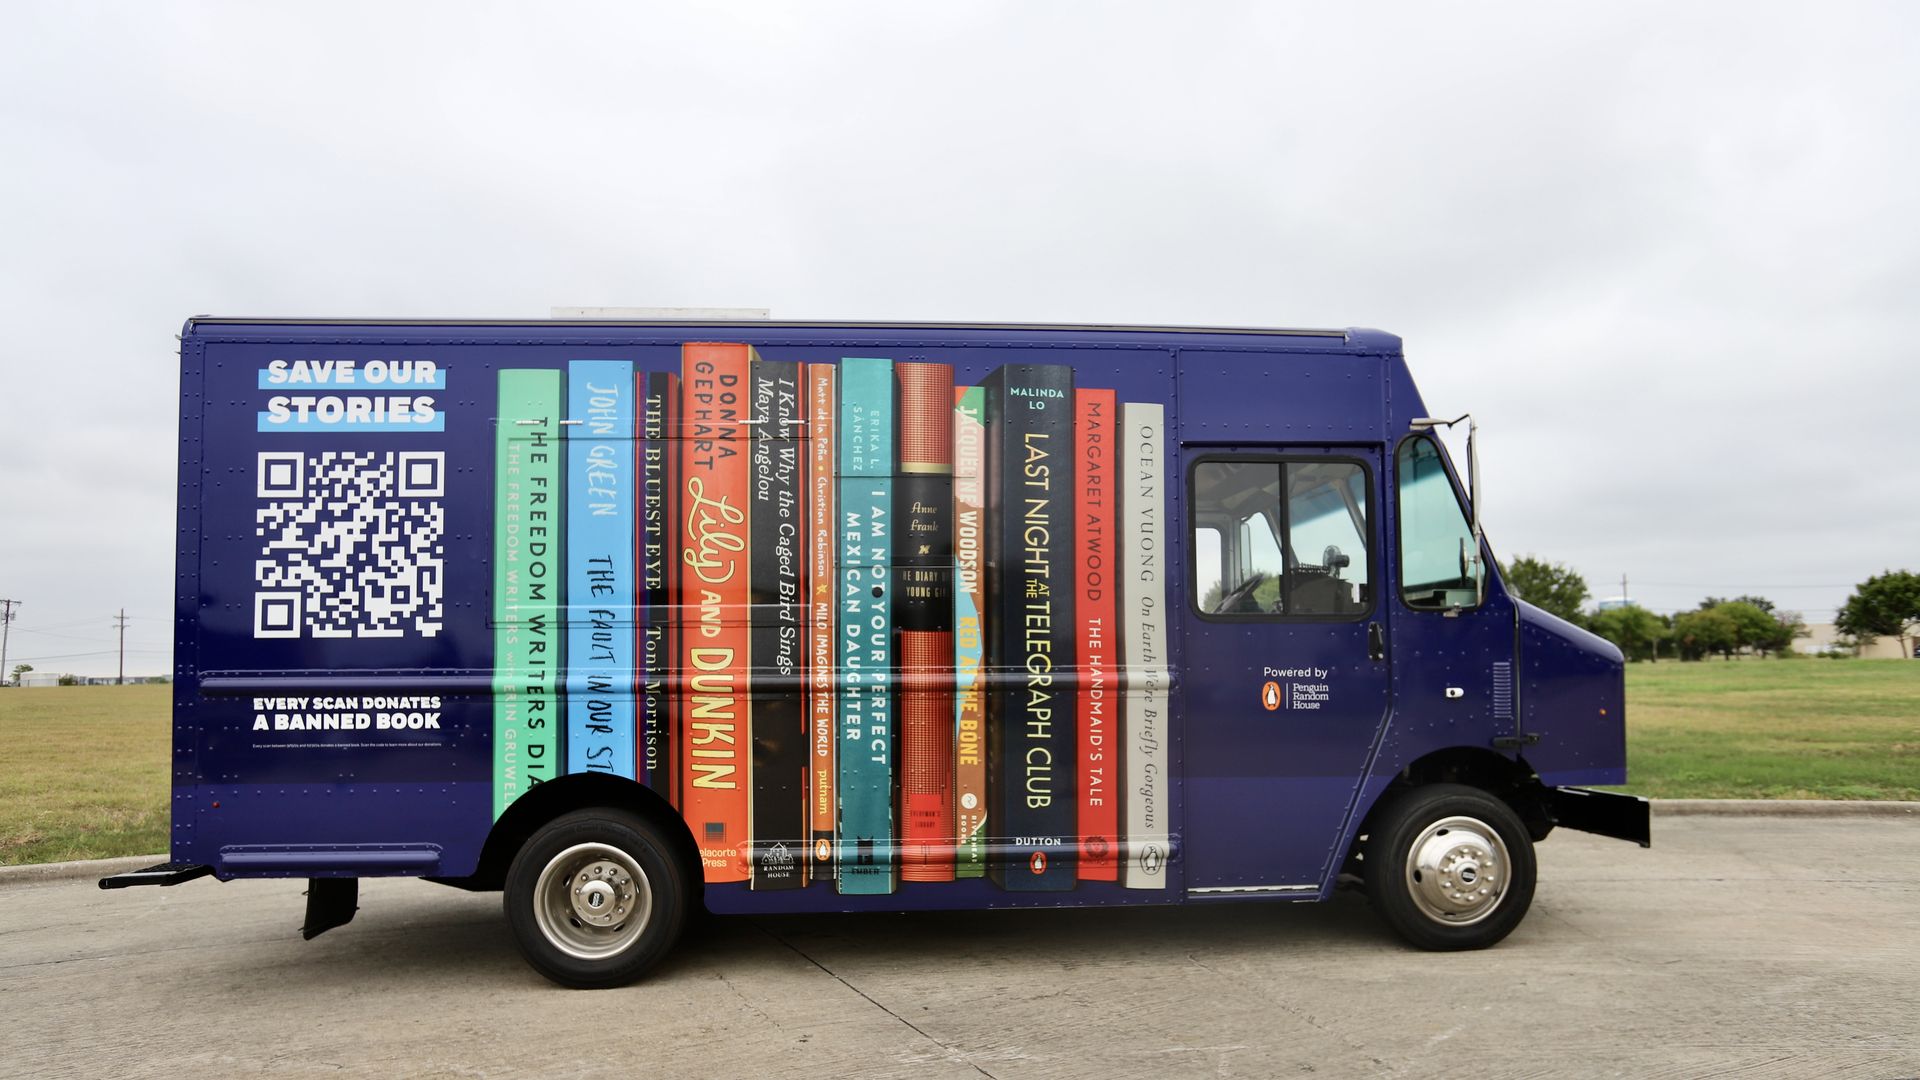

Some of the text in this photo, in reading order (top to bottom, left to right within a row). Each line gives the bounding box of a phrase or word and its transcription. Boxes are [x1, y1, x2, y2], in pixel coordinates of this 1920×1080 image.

[268, 359, 436, 384] SAVE OUR
[817, 377, 828, 404] Matt
[267, 396, 436, 424] STORIES
[1010, 387, 1064, 398] MALINDA
[1029, 401, 1045, 410] LO
[693, 361, 714, 470] GEPHART
[718, 374, 738, 459] DONNA
[817, 408, 828, 420] de
[817, 423, 828, 433] la
[586, 382, 618, 516] JOHN GREEN
[754, 377, 774, 501] Maya Angelou
[852, 406, 863, 471] SÁNCHEZ
[870, 410, 880, 469] ERIKA L.
[508, 445, 520, 474] THE
[645, 394, 661, 590] THE BLUEST EYE
[817, 476, 828, 524] Christian
[910, 501, 937, 513] Anne
[959, 405, 978, 593] JACQUELINE WOODSON
[507, 483, 520, 562] FREEDOM
[775, 377, 795, 675] I Know Why the Caged Bird Sings
[871, 506, 886, 537] AM
[910, 519, 938, 531] Frank
[817, 529, 828, 577] Robinson
[871, 548, 886, 594] NOT
[587, 555, 615, 598] THE
[906, 586, 930, 597] YOUNG
[915, 571, 938, 581] DIARY
[504, 567, 519, 645] WRITERS
[527, 417, 548, 789] THE FREEDOM WRITERS DIA
[816, 602, 828, 629] MILO
[1024, 433, 1052, 809] LAST NIGHT AT THE TELEGRAPH CLUB
[1087, 402, 1103, 807] MARGARET ATWOOD THE HANDMAID'S TALE
[589, 609, 616, 664] FAULT
[684, 476, 745, 789] Lily AND DUNKIN
[846, 512, 861, 740] MEXICAN DAUGHTER
[871, 602, 886, 662] YOUR
[1139, 426, 1159, 828] OCEAN VUONG On Earth Were Briefly Gorgeous
[816, 635, 829, 689] IMAGINES
[1264, 667, 1328, 679] Powered by
[253, 696, 441, 710] EVERY SCAN DONATES
[504, 683, 518, 721] ERIN
[587, 675, 614, 695] IN
[645, 626, 662, 770] Toni Morrison
[816, 692, 829, 714] THE
[959, 617, 978, 765] RED AT THE BONE
[1293, 683, 1329, 693] Penguin
[1293, 692, 1329, 701] Random
[1293, 701, 1320, 709] House
[252, 712, 441, 730] A BANNED BOOK
[585, 700, 613, 735] OUR
[817, 718, 829, 757] WORLD
[871, 673, 886, 765] PERFECT
[817, 770, 828, 815] putnam
[699, 848, 737, 858] elacorte
[1015, 837, 1061, 846] DUTTON
[702, 858, 727, 868] Press
